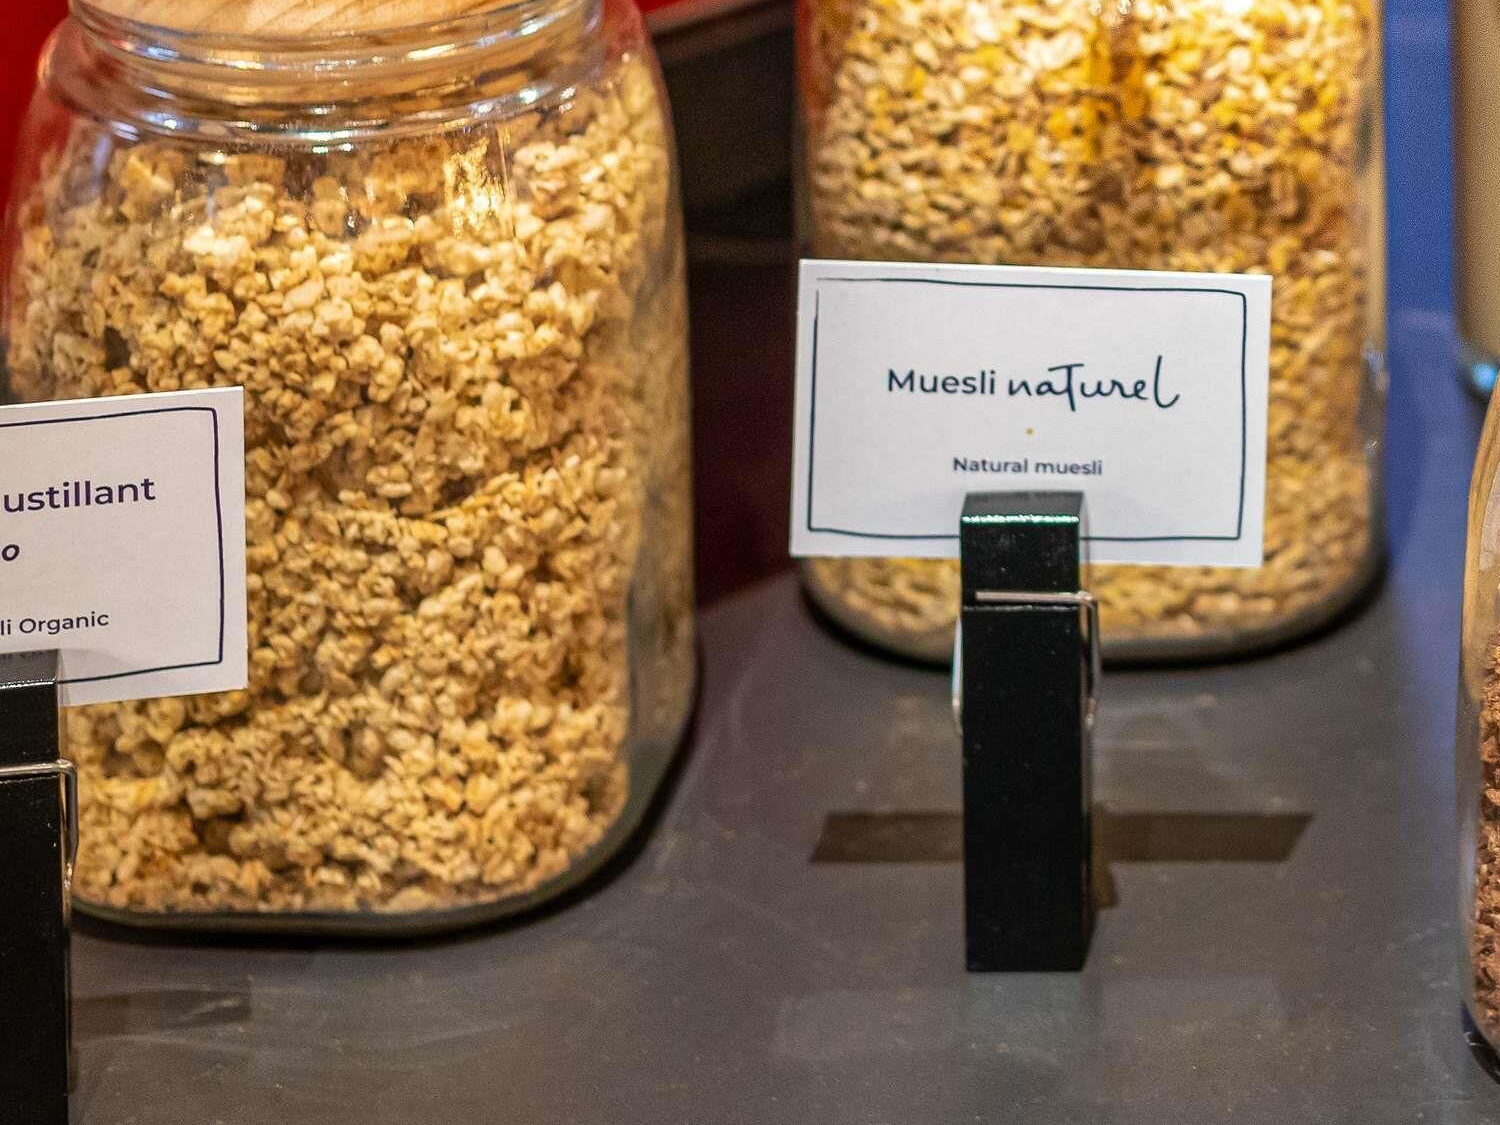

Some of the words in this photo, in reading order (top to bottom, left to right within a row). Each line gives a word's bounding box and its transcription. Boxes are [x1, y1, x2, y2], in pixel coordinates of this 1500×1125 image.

[887, 368, 996, 395] Muesli
[953, 457, 1028, 473] Natural
[1035, 460, 1103, 475] muesli
[18, 610, 109, 636] Organic
